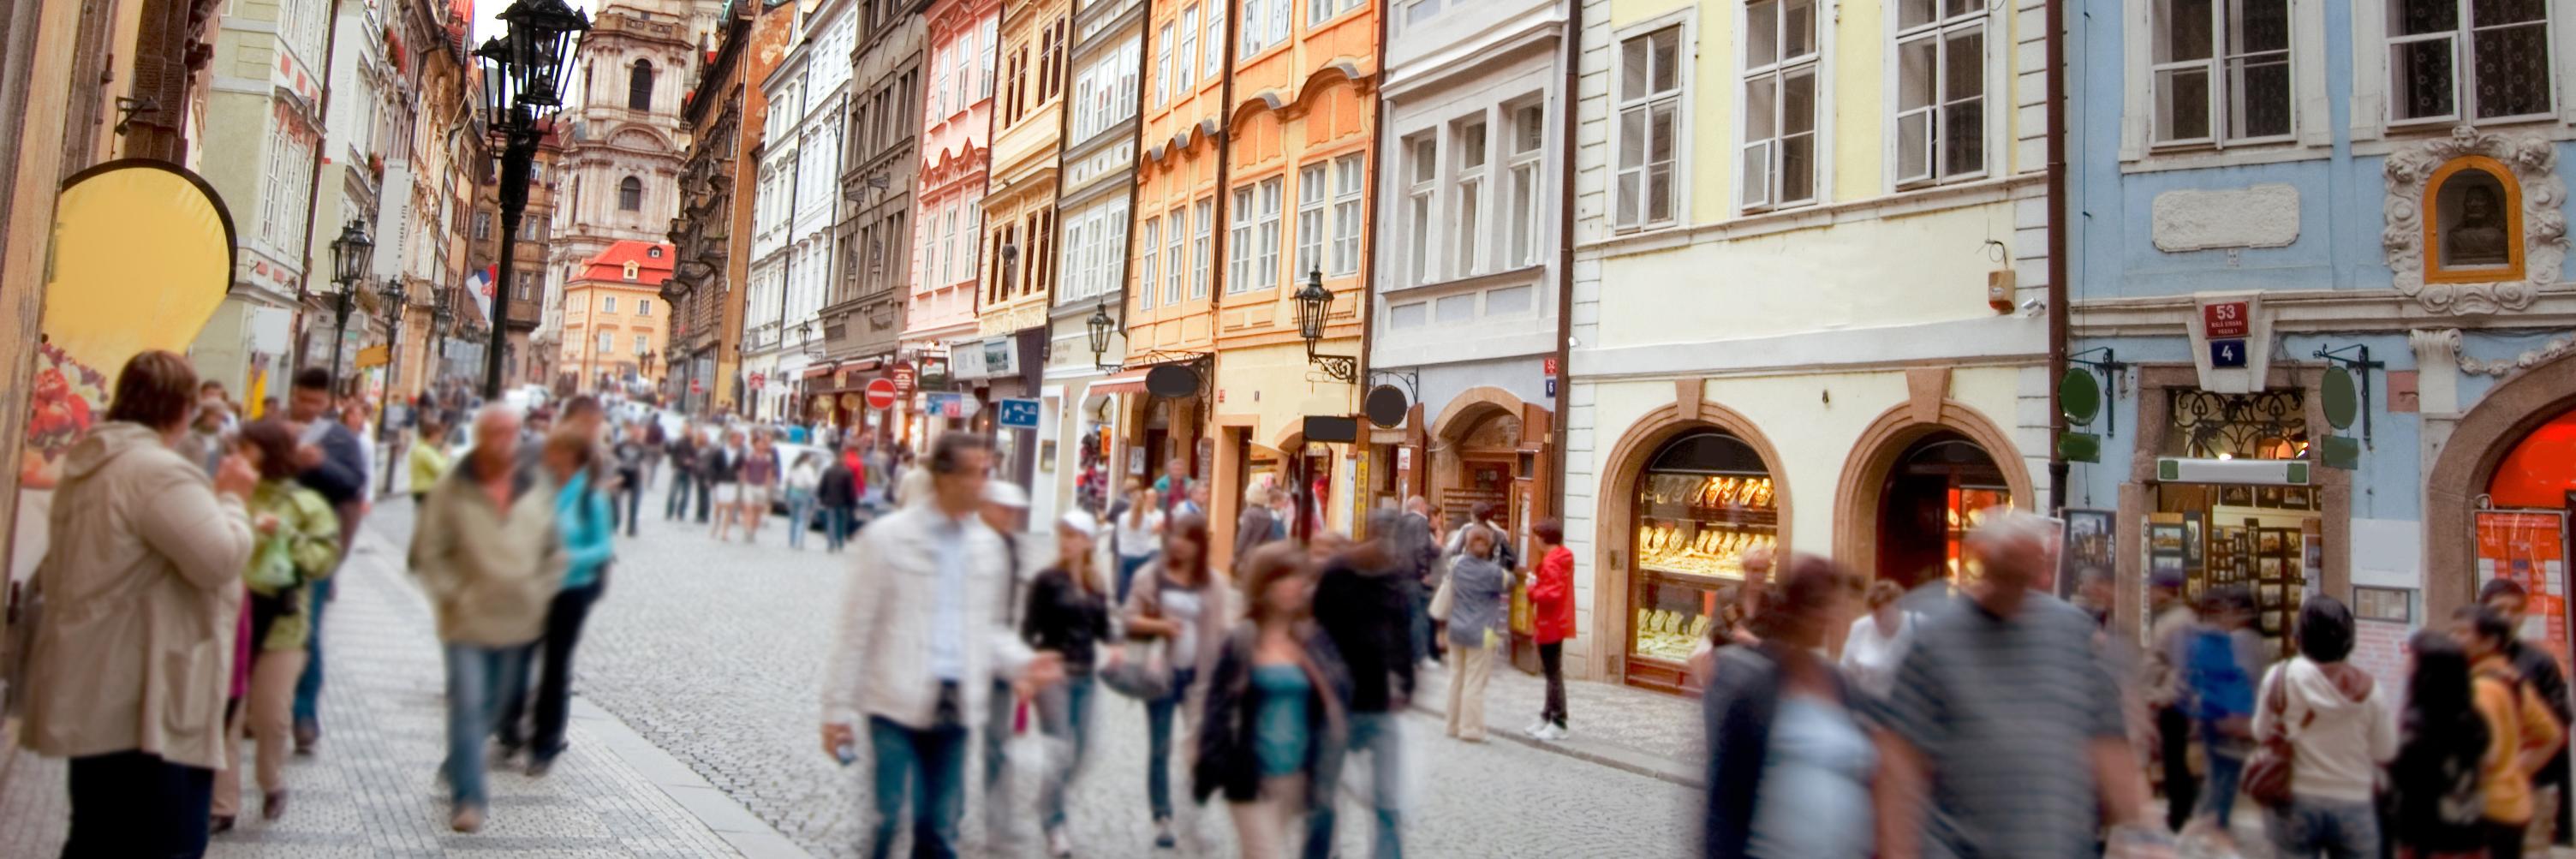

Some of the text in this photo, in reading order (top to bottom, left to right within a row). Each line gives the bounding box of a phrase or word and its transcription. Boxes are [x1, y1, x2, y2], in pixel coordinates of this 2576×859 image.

[2216, 305, 2235, 319] 53
[2221, 344, 2234, 361] 4
[1548, 382, 1554, 393] 6
